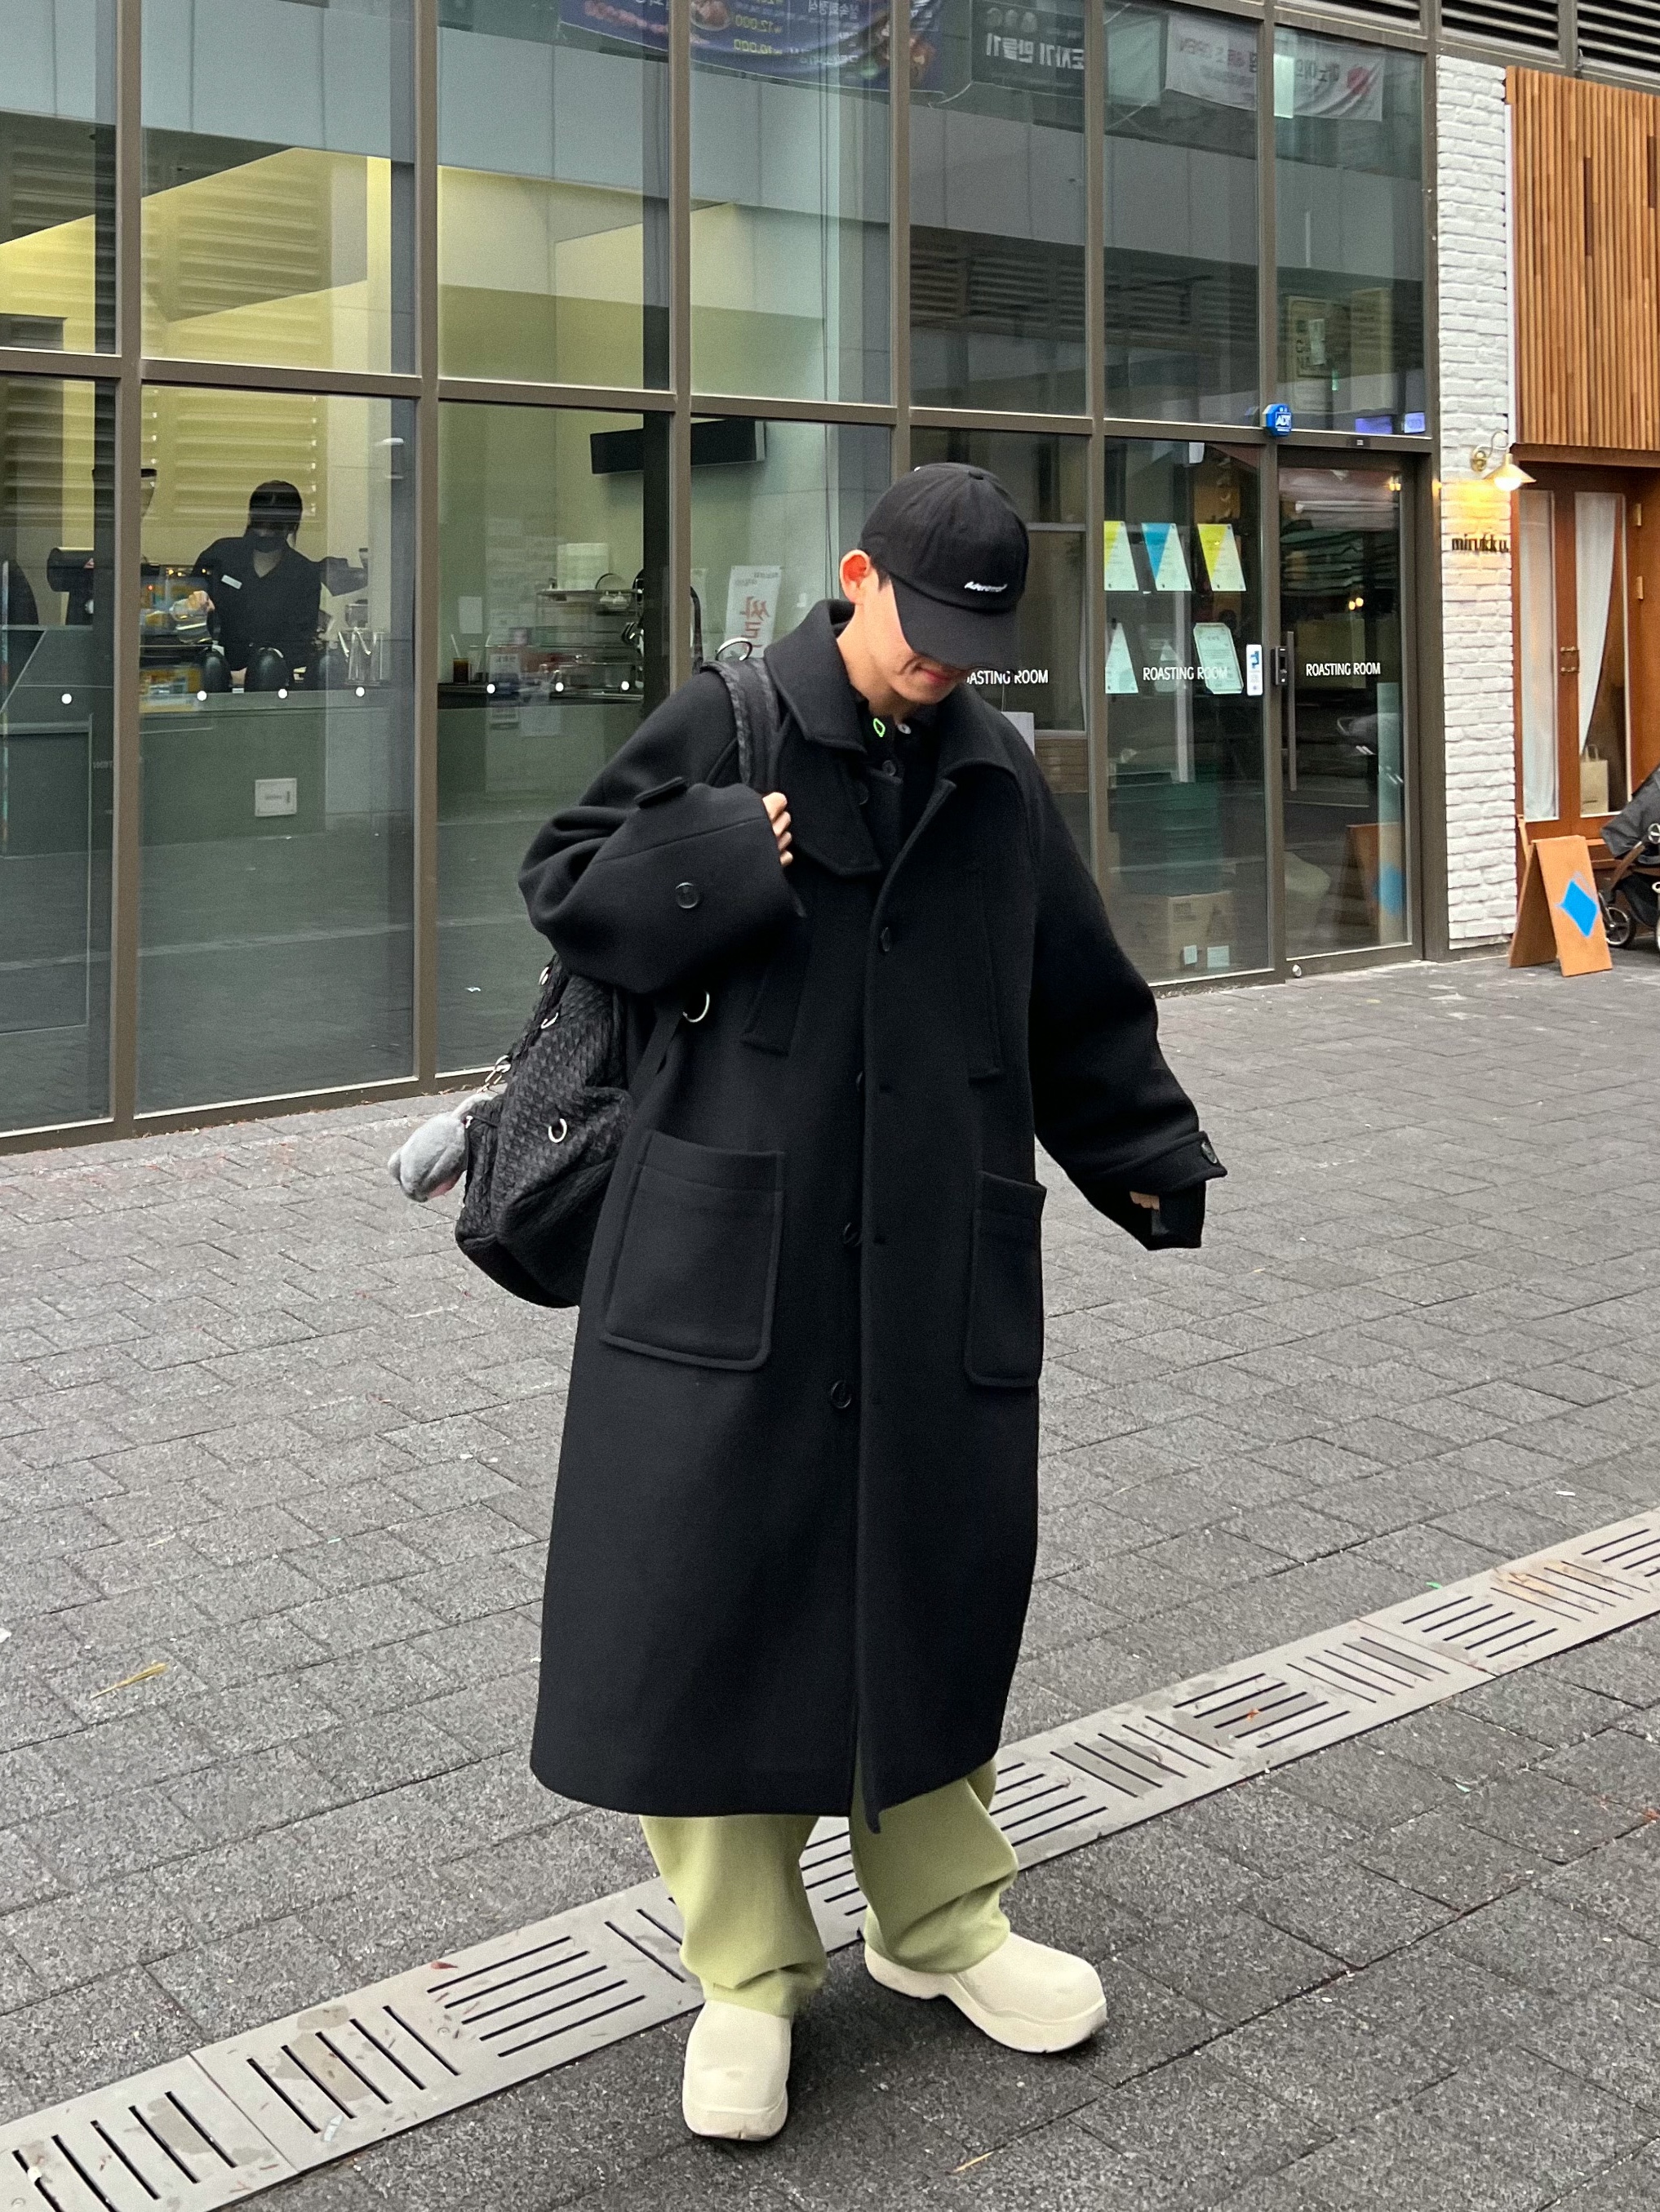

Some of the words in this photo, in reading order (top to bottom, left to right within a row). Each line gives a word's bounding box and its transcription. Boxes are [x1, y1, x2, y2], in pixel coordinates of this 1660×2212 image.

[1276, 415, 1291, 426] ADT
[1143, 666, 1194, 681] ROASTING
[1197, 665, 1228, 680] ROOM
[1306, 663, 1352, 676] ROASTING
[1353, 662, 1381, 674] ROOM
[966, 670, 1011, 685] ASTING
[1014, 669, 1049, 684] ROOM
